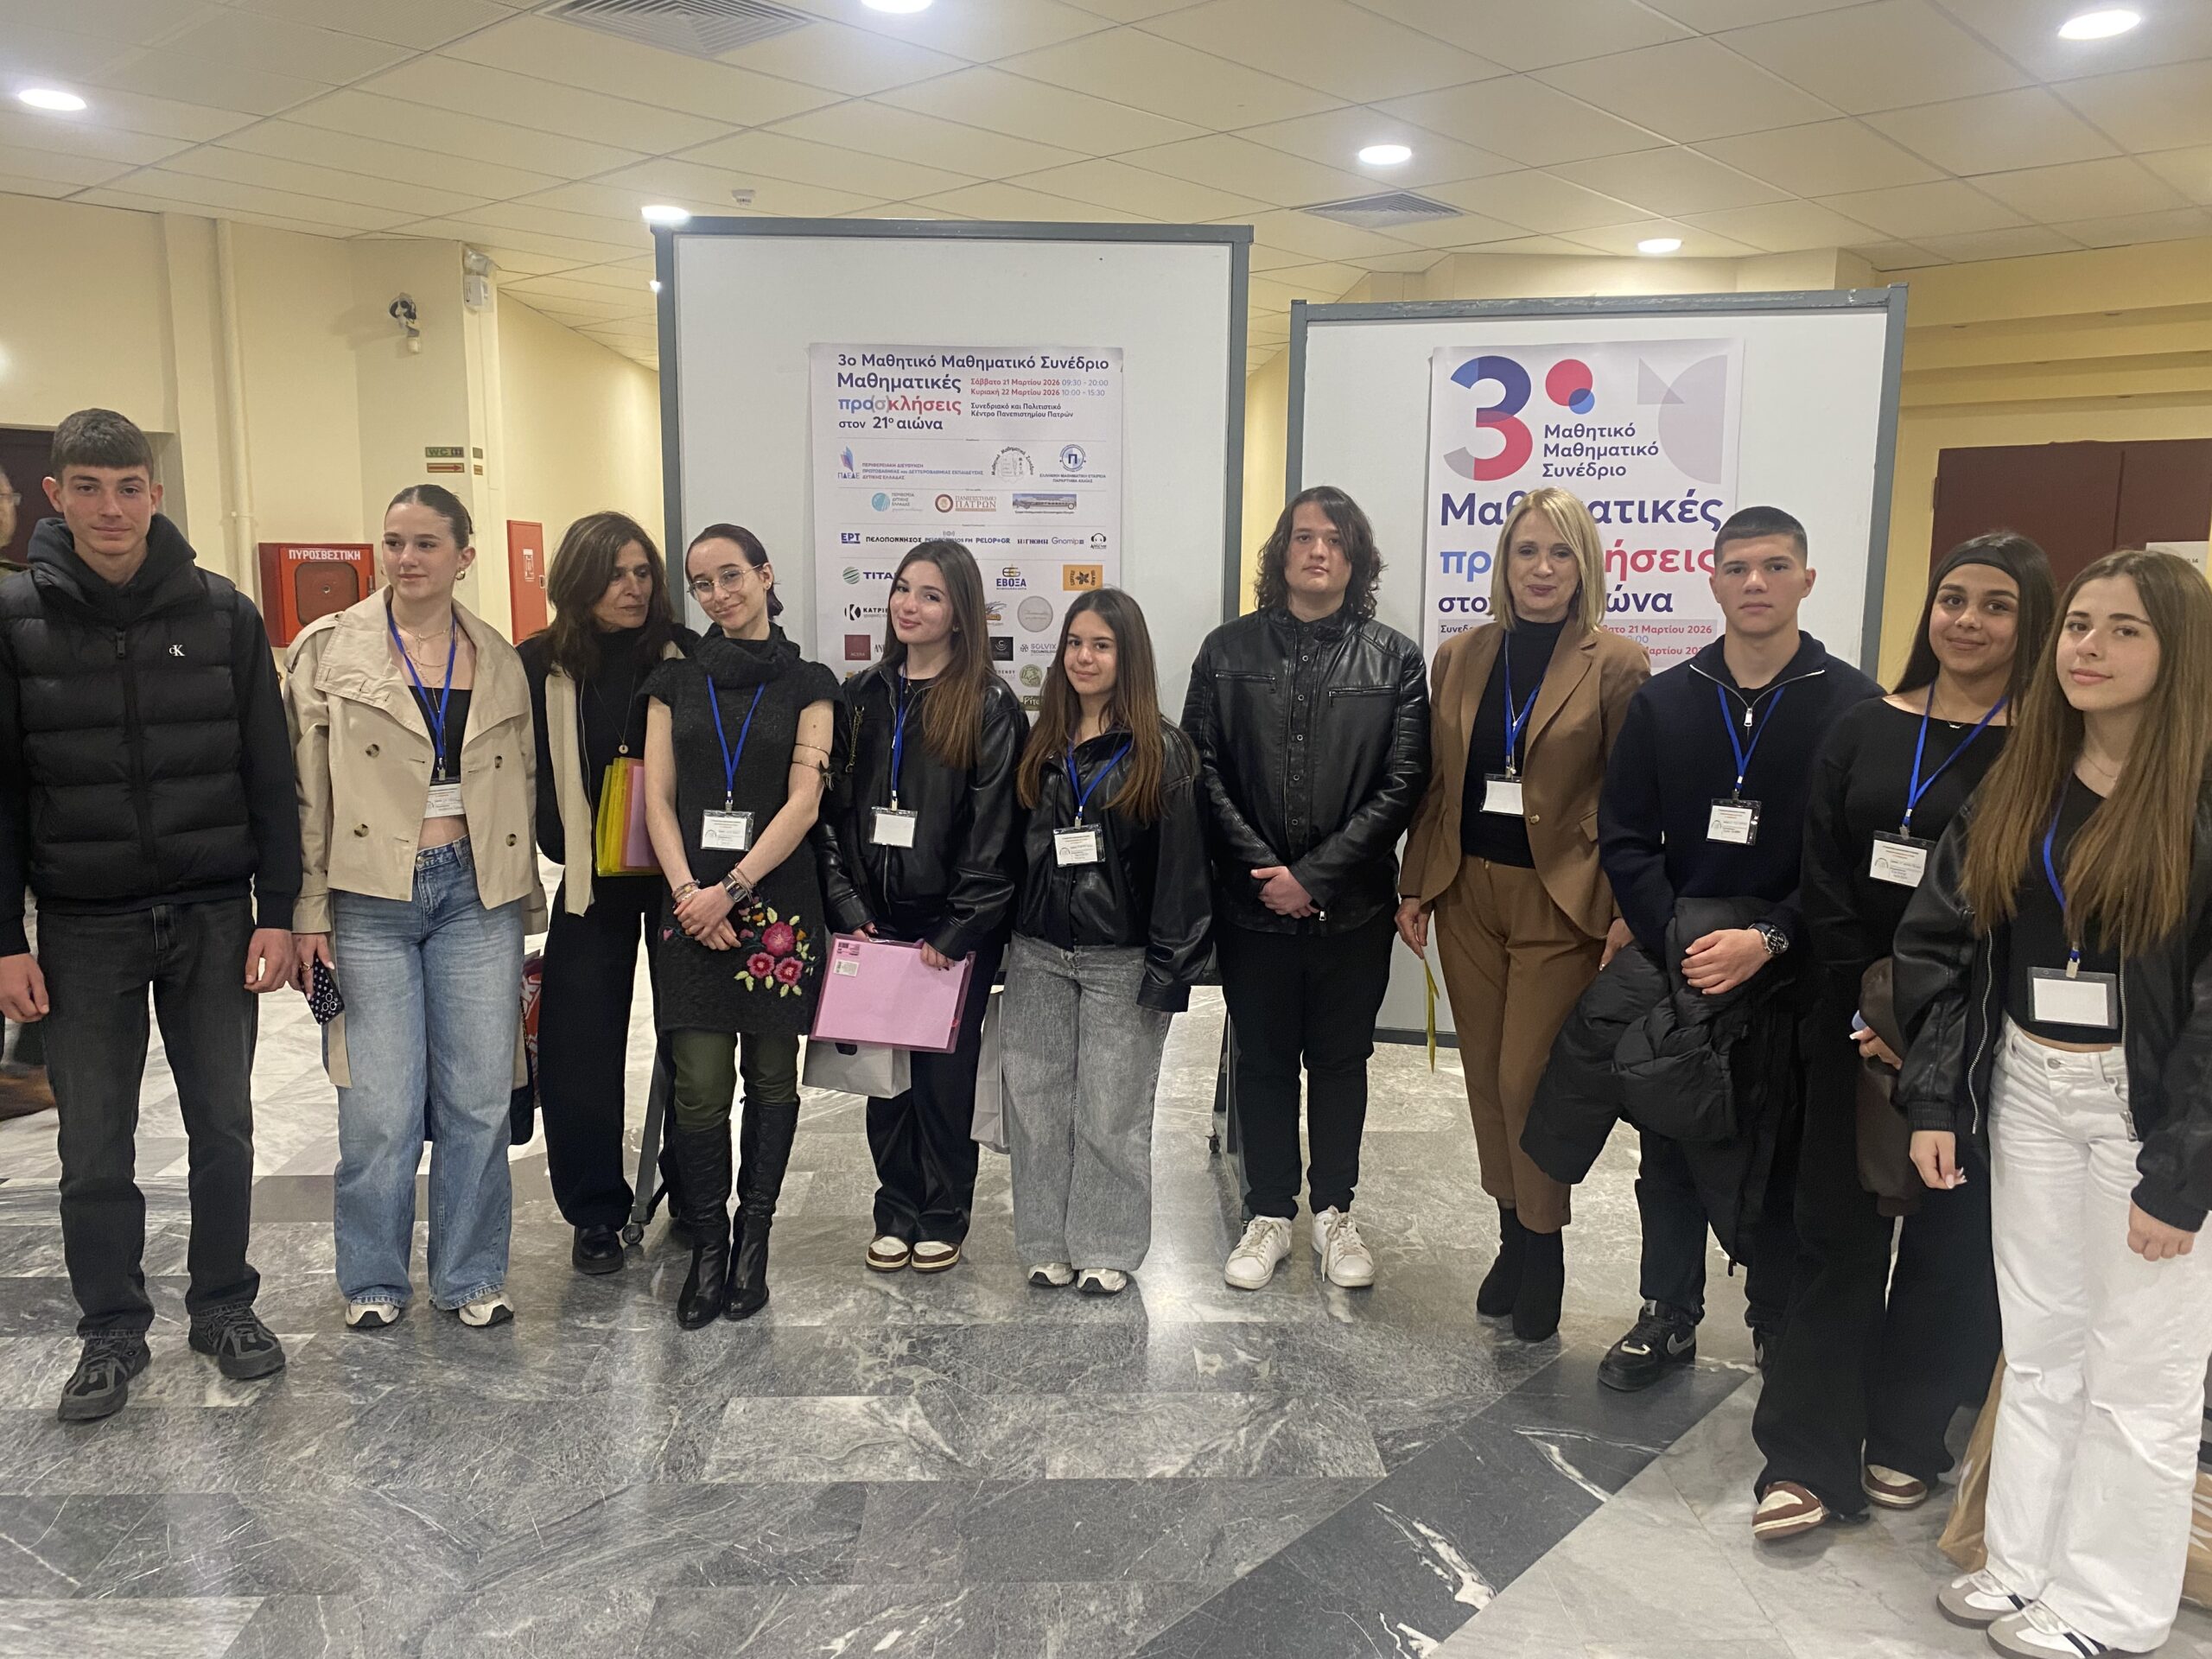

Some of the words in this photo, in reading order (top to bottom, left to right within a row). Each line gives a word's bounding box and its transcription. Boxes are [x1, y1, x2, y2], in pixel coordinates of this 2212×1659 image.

[838, 353, 856, 366] 3ο
[861, 353, 937, 370] Μαθητικό
[942, 354, 1036, 372] Μαθηματικό
[1040, 356, 1109, 372] Συνέδριο
[837, 372, 961, 393] Μαθηματικές
[1012, 378, 1041, 388] Μαρτίου
[970, 389, 1000, 397] Κυριακή
[1011, 389, 1041, 397] Μαρτίου
[996, 410, 1046, 419] Πανεπιστημίου
[838, 420, 866, 429] στον
[896, 416, 944, 429] αιώνα
[1544, 422, 1636, 442] Μαθητικό
[1543, 441, 1659, 461] Μαθηματικό
[1541, 461, 1627, 480] Συνέδριο
[288, 549, 361, 561] ΠΥΡΟΣΒΕΣΤΙΚΗ
[1438, 595, 1491, 613] στο
[1628, 625, 1639, 633] 21
[1642, 625, 1684, 635] Μαρτίου
[1688, 625, 1713, 633] 2026
